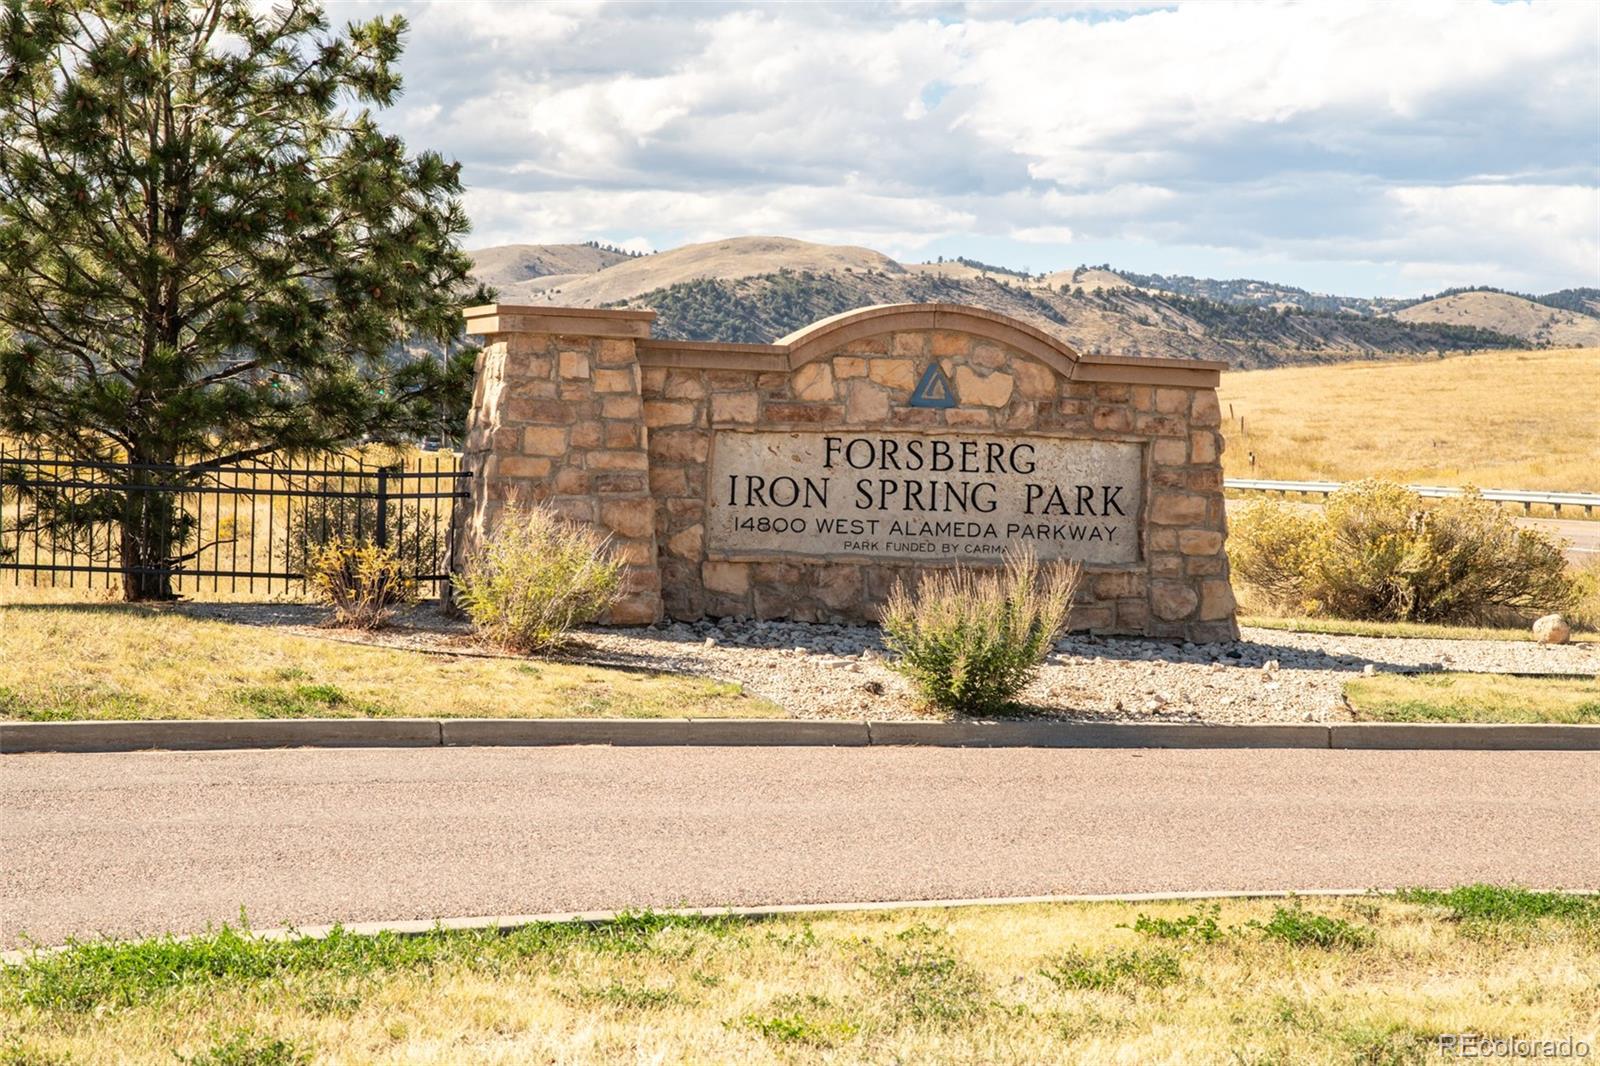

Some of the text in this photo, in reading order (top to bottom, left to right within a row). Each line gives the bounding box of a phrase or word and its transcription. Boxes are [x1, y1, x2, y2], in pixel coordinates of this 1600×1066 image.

[823, 437, 1036, 475] FORSBERG
[728, 474, 1126, 516] IRON SPRING PARK
[734, 516, 1118, 542] 14800 WEST ALAMEDA PARKWAY
[843, 540, 879, 551] PARK
[885, 541, 936, 553] FUNDED
[942, 543, 959, 553] BY
